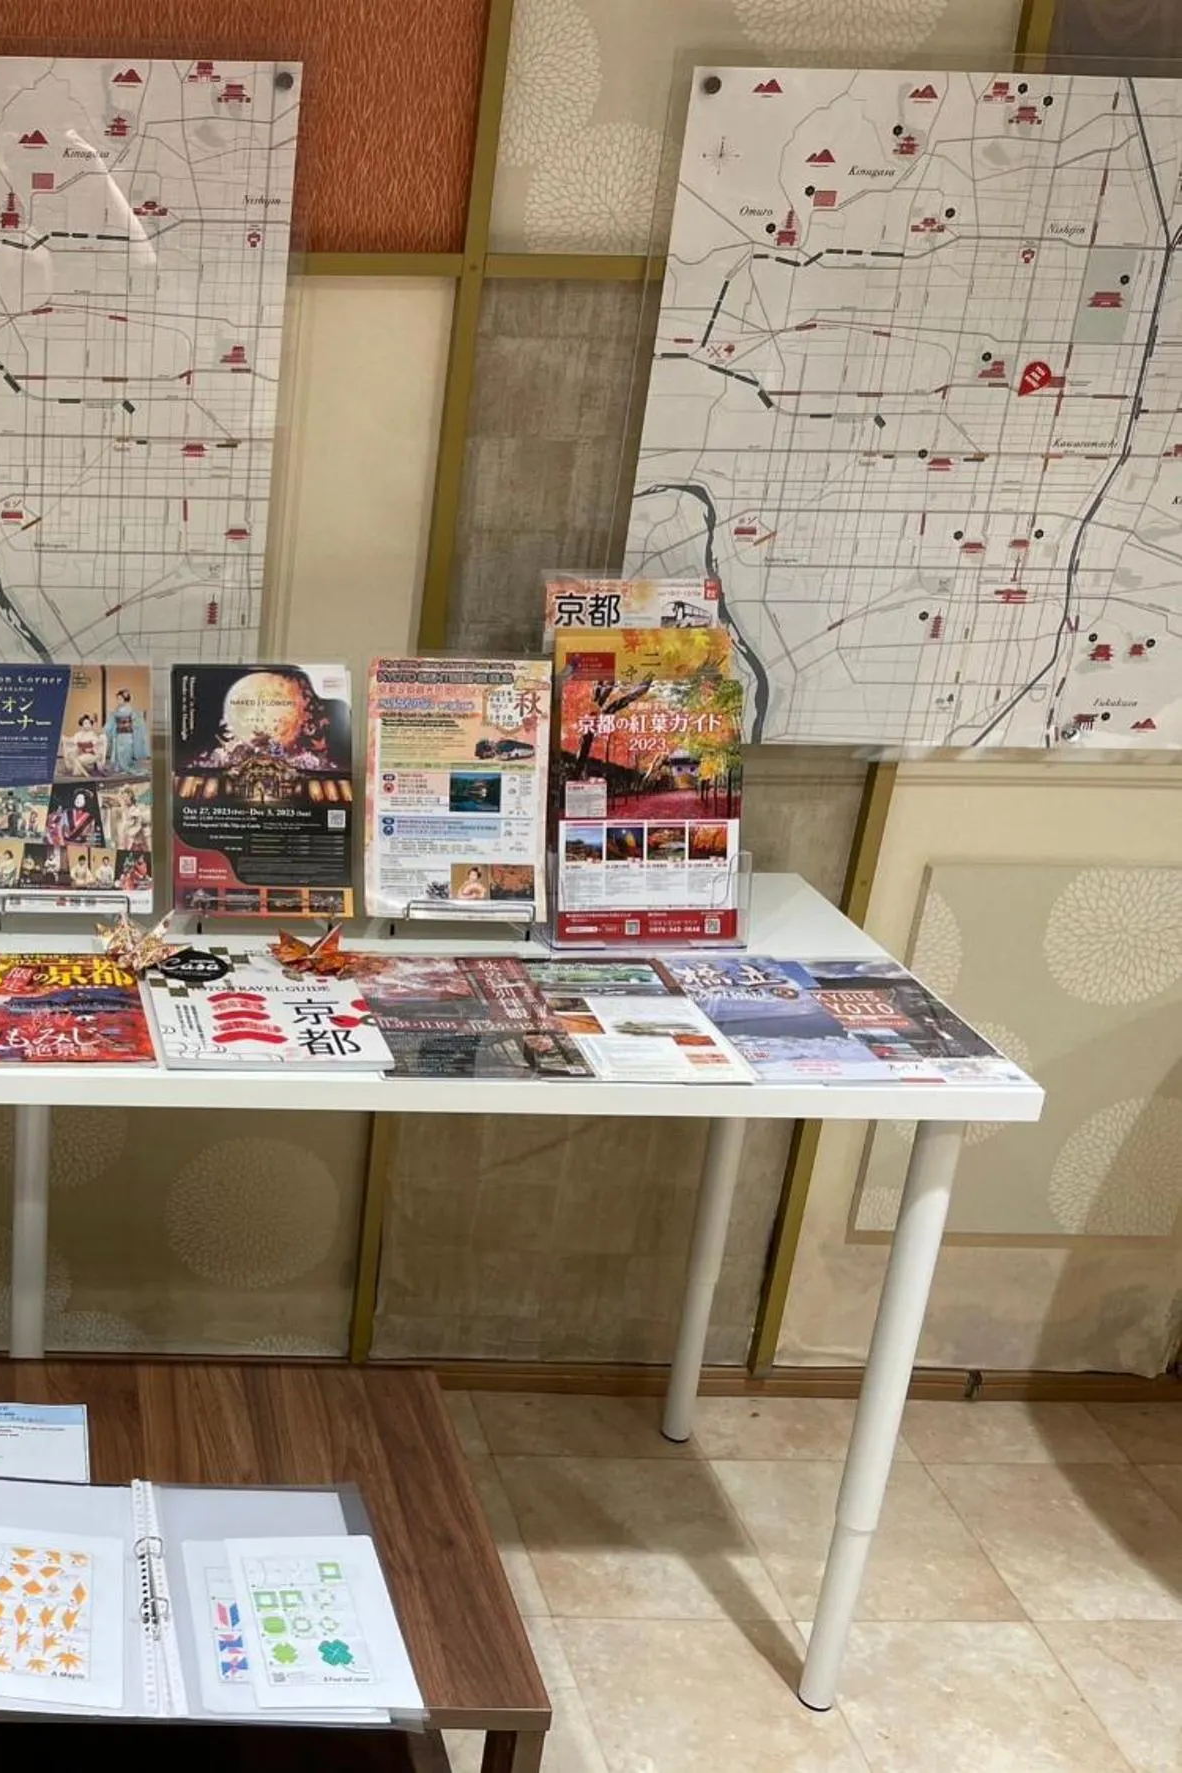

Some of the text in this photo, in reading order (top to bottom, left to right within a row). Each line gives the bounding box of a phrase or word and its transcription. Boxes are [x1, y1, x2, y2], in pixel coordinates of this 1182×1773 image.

[739, 206, 773, 217] Omuro
[555, 593, 621, 628] 京都
[514, 691, 541, 717] 秋
[577, 713, 722, 735] 京都の紅葉ガイド
[629, 736, 667, 751] 2023
[161, 957, 220, 970] Casa
[285, 985, 330, 993] GUIDE
[825, 1002, 895, 1016] YOTO
[283, 998, 362, 1056] 京都
[7, 1026, 100, 1048] もみじ
